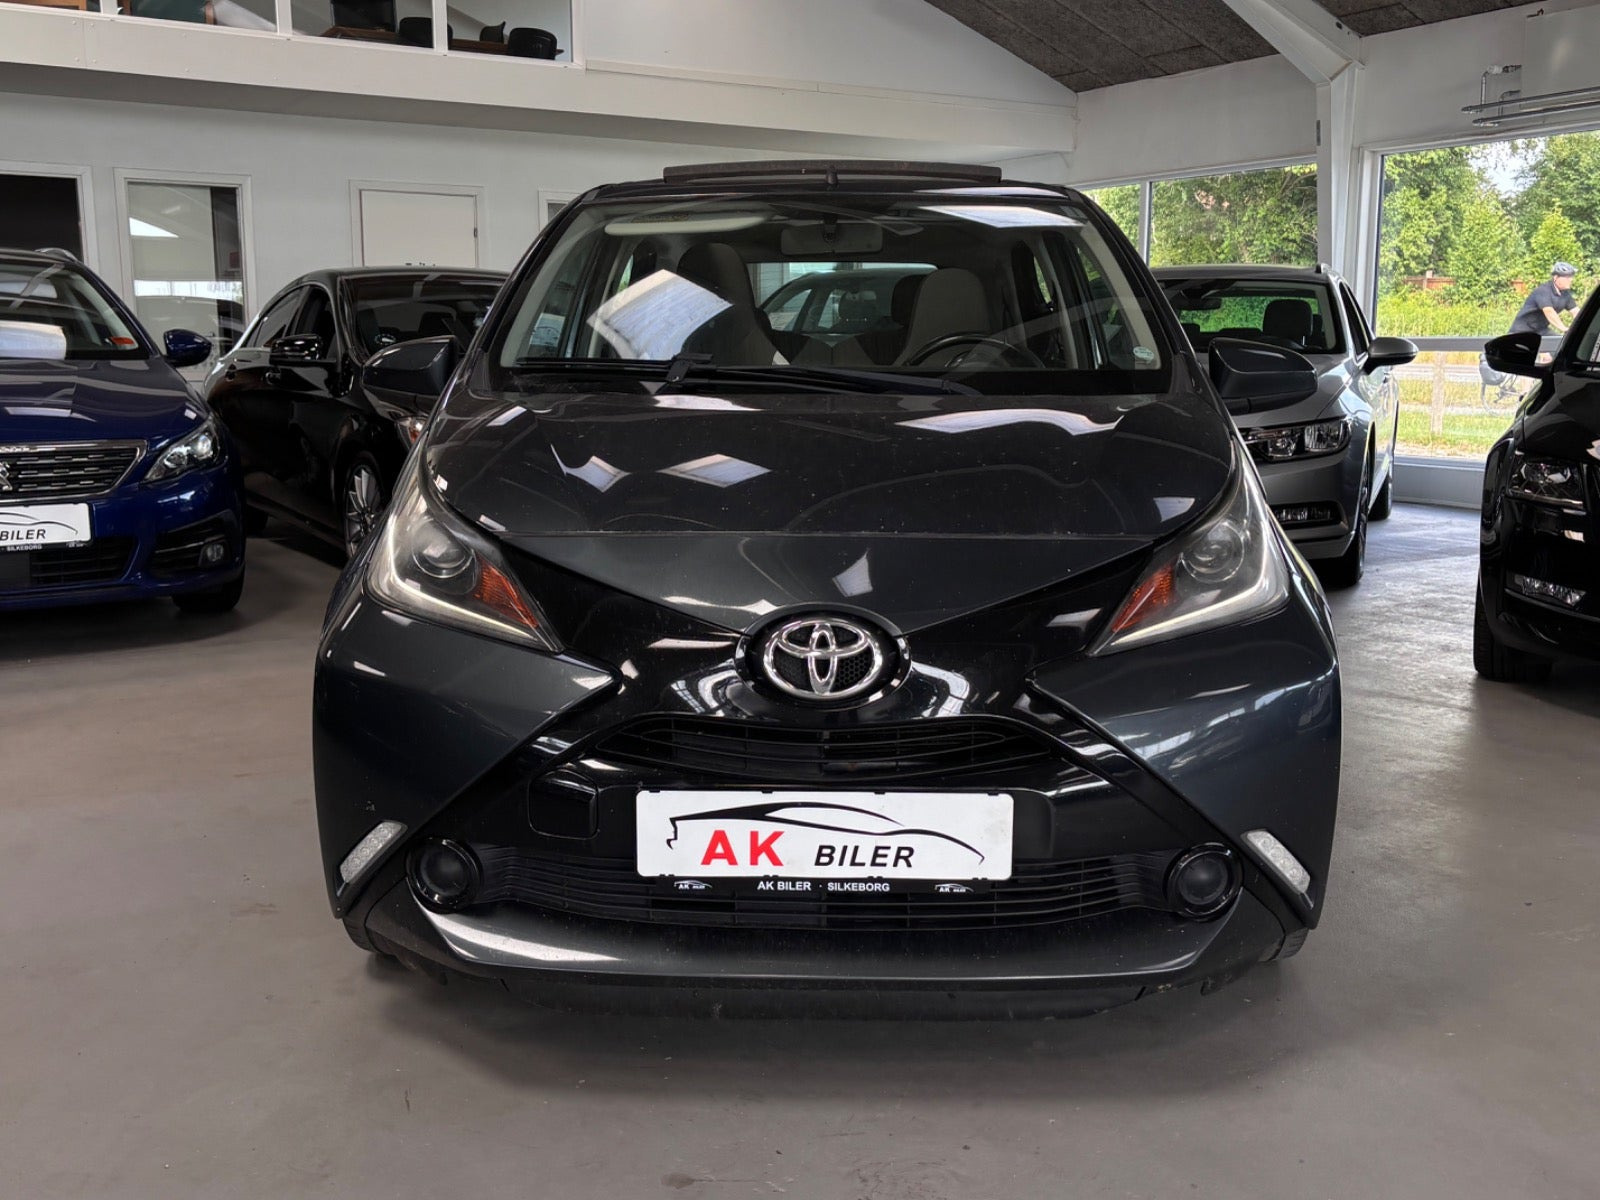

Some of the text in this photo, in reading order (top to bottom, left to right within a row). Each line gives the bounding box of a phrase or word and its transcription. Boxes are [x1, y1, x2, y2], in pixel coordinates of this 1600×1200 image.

[0, 529, 46, 541] BILER
[700, 829, 915, 868] AK BILER
[757, 880, 891, 892] AK BILER SILKEBORG
